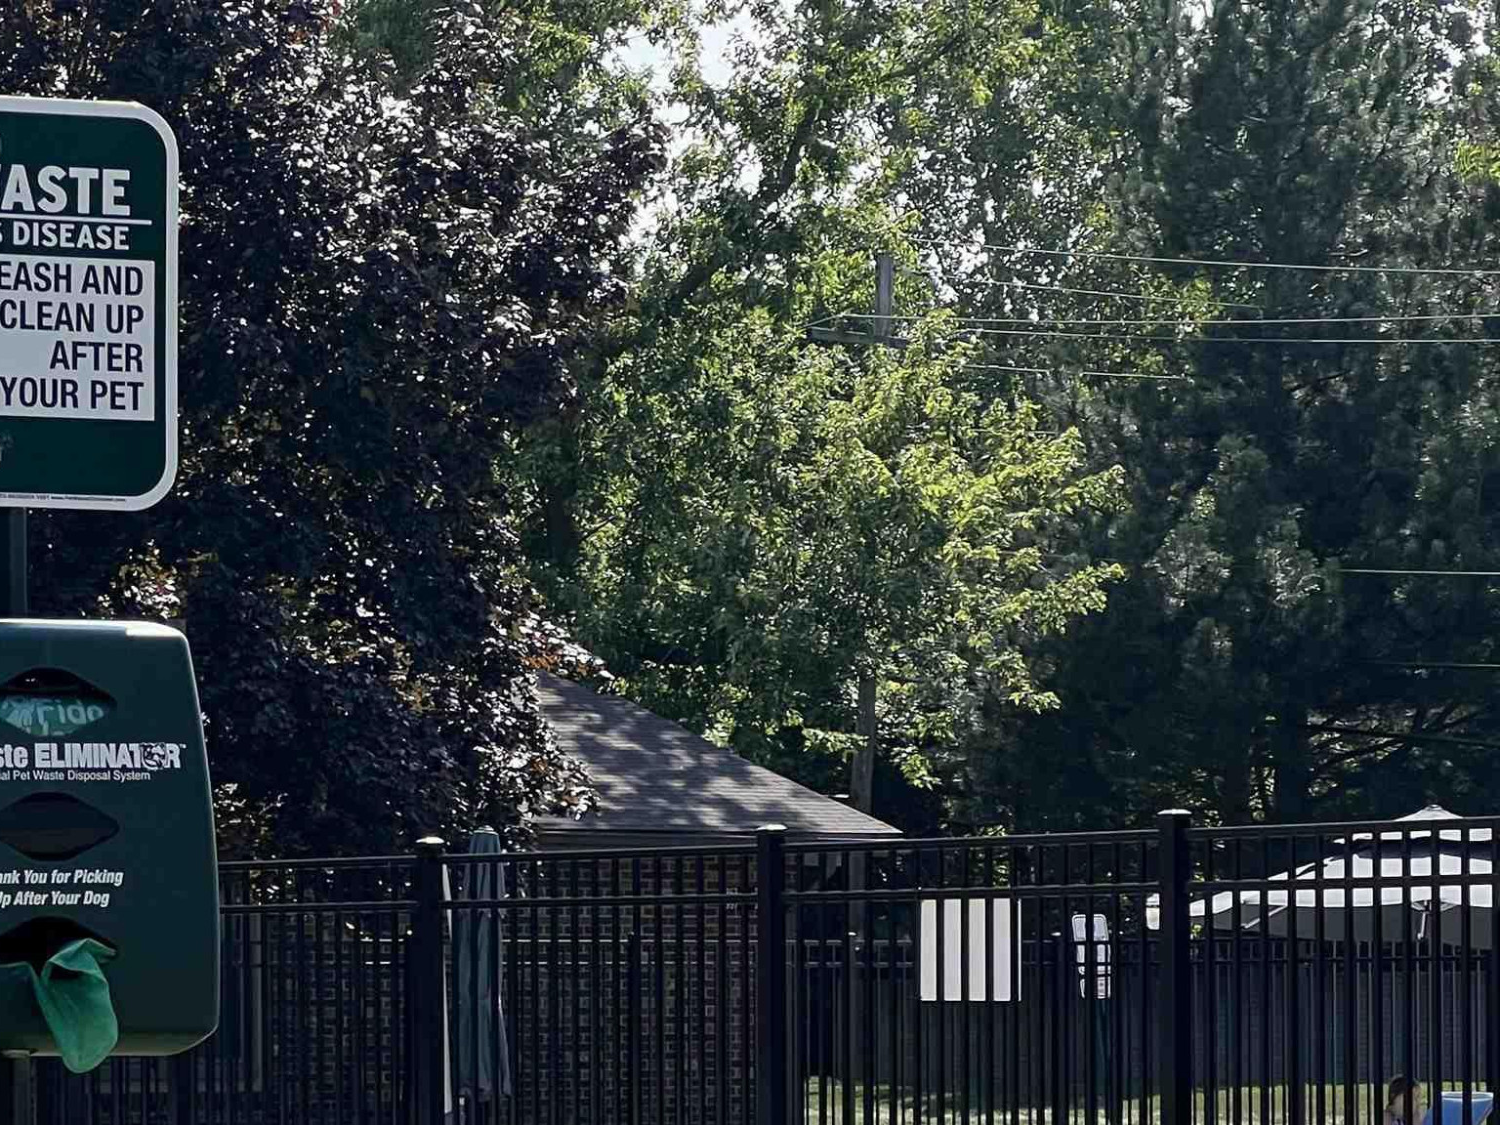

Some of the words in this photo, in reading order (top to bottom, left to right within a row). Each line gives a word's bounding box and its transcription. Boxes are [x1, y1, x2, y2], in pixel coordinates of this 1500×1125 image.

[13, 221, 129, 251] DISEASE
[81, 264, 144, 296] AND
[0, 299, 94, 333] CLEAN
[106, 304, 144, 334] UP
[50, 340, 144, 372] AFTER
[0, 376, 79, 409] YOUR
[91, 380, 144, 411] PET
[13, 770, 30, 781] Pet
[33, 770, 64, 781] Waste
[67, 770, 110, 783] Disposal
[113, 770, 150, 783] System
[24, 869, 48, 884] You
[51, 869, 71, 884] for
[73, 869, 124, 887] Picking
[13, 891, 48, 905] After
[51, 891, 81, 905] Your
[83, 890, 110, 908] Dog
